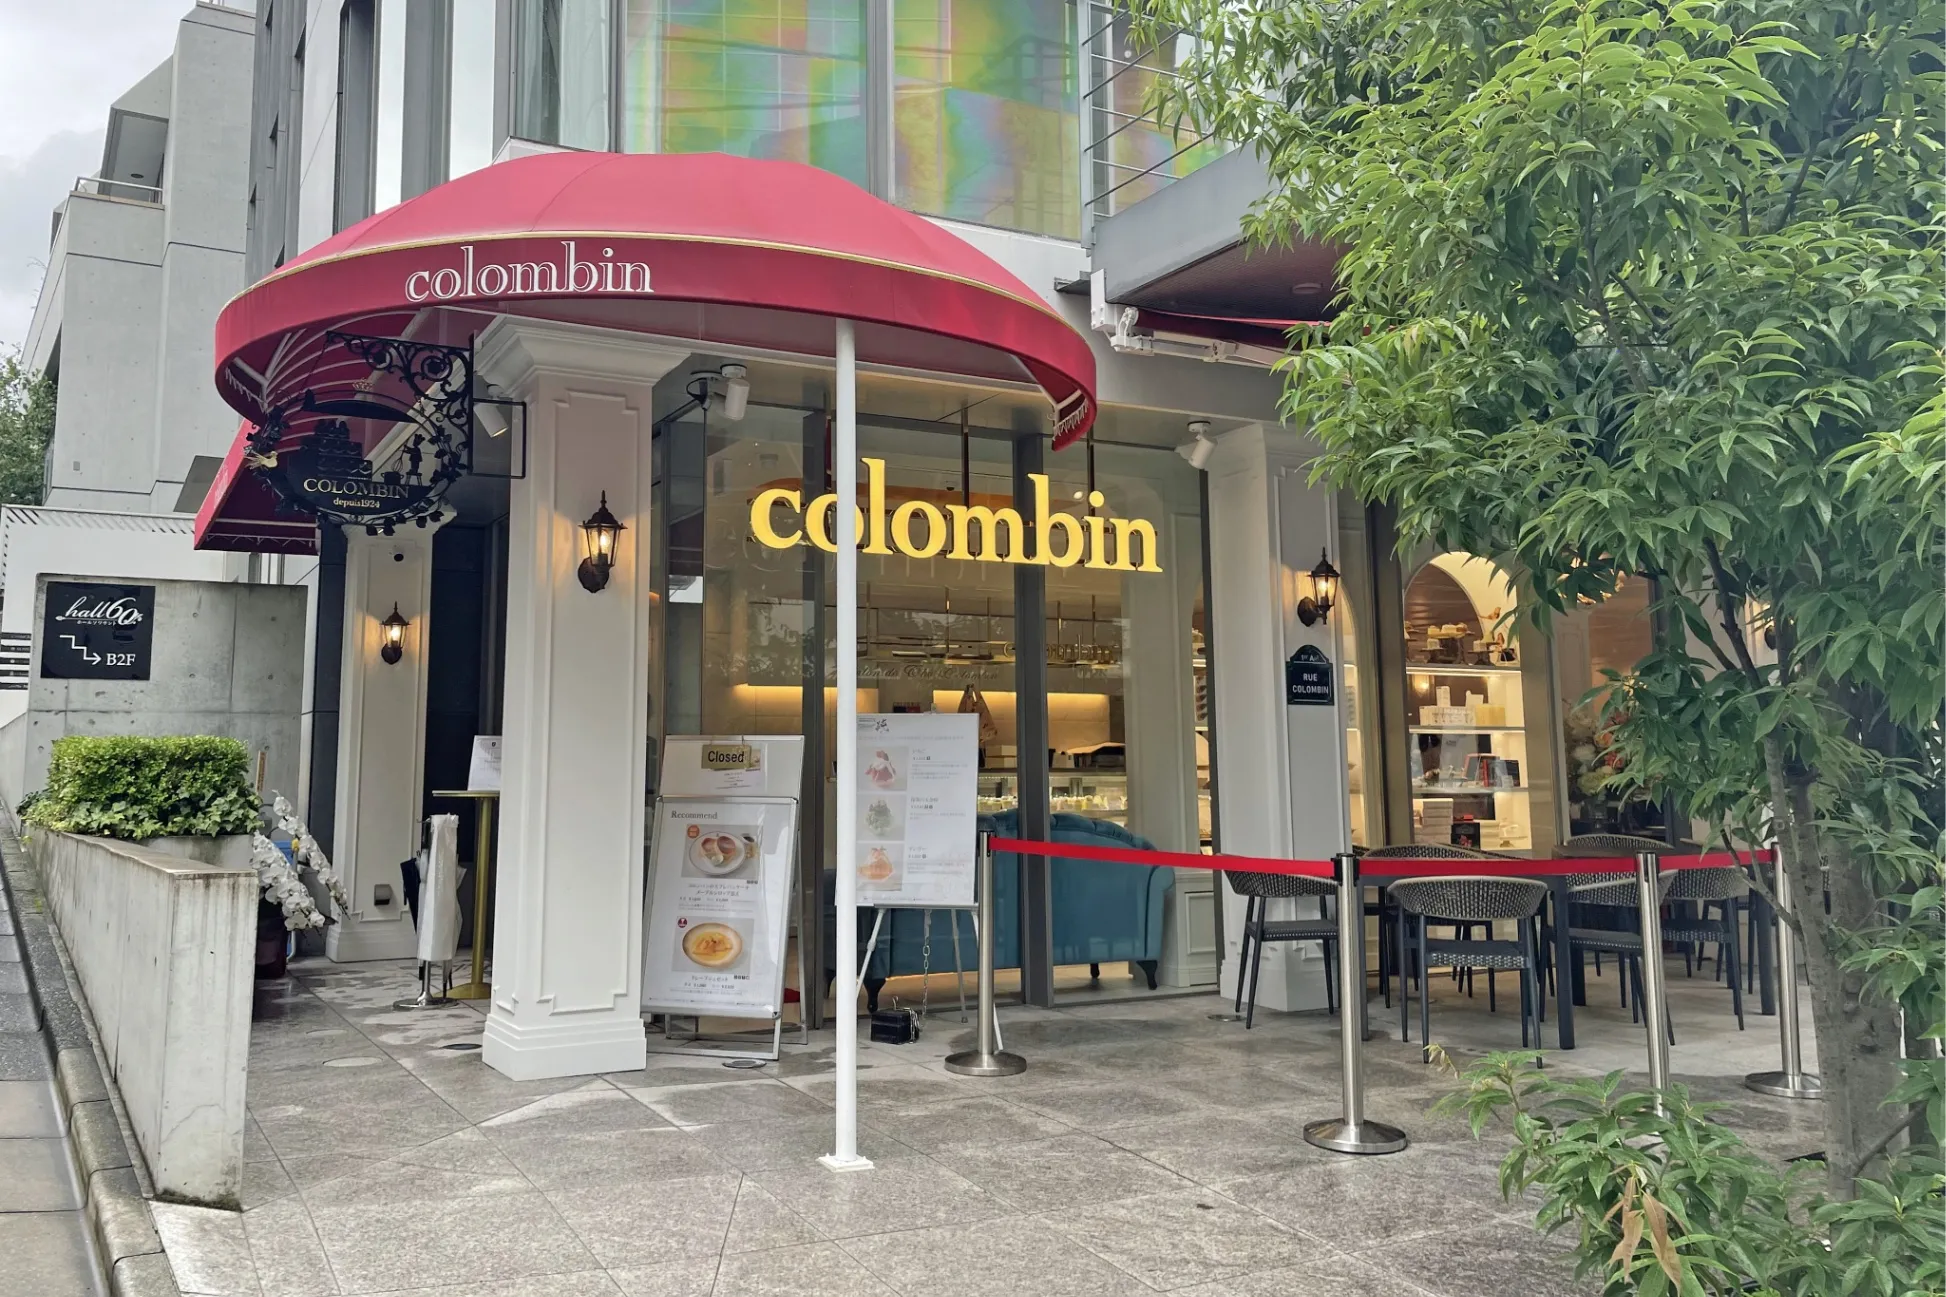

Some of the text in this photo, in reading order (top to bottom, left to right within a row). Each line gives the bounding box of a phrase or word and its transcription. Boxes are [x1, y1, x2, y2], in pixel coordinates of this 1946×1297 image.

[405, 240, 654, 303] colombin
[303, 478, 409, 499] COLOMBIN
[749, 457, 1163, 573] colombin
[106, 653, 136, 666] B2F
[1303, 673, 1318, 681] RUE
[1292, 685, 1329, 694] COLOMBIN
[707, 750, 745, 763] Closed
[670, 810, 718, 820] Recommend
